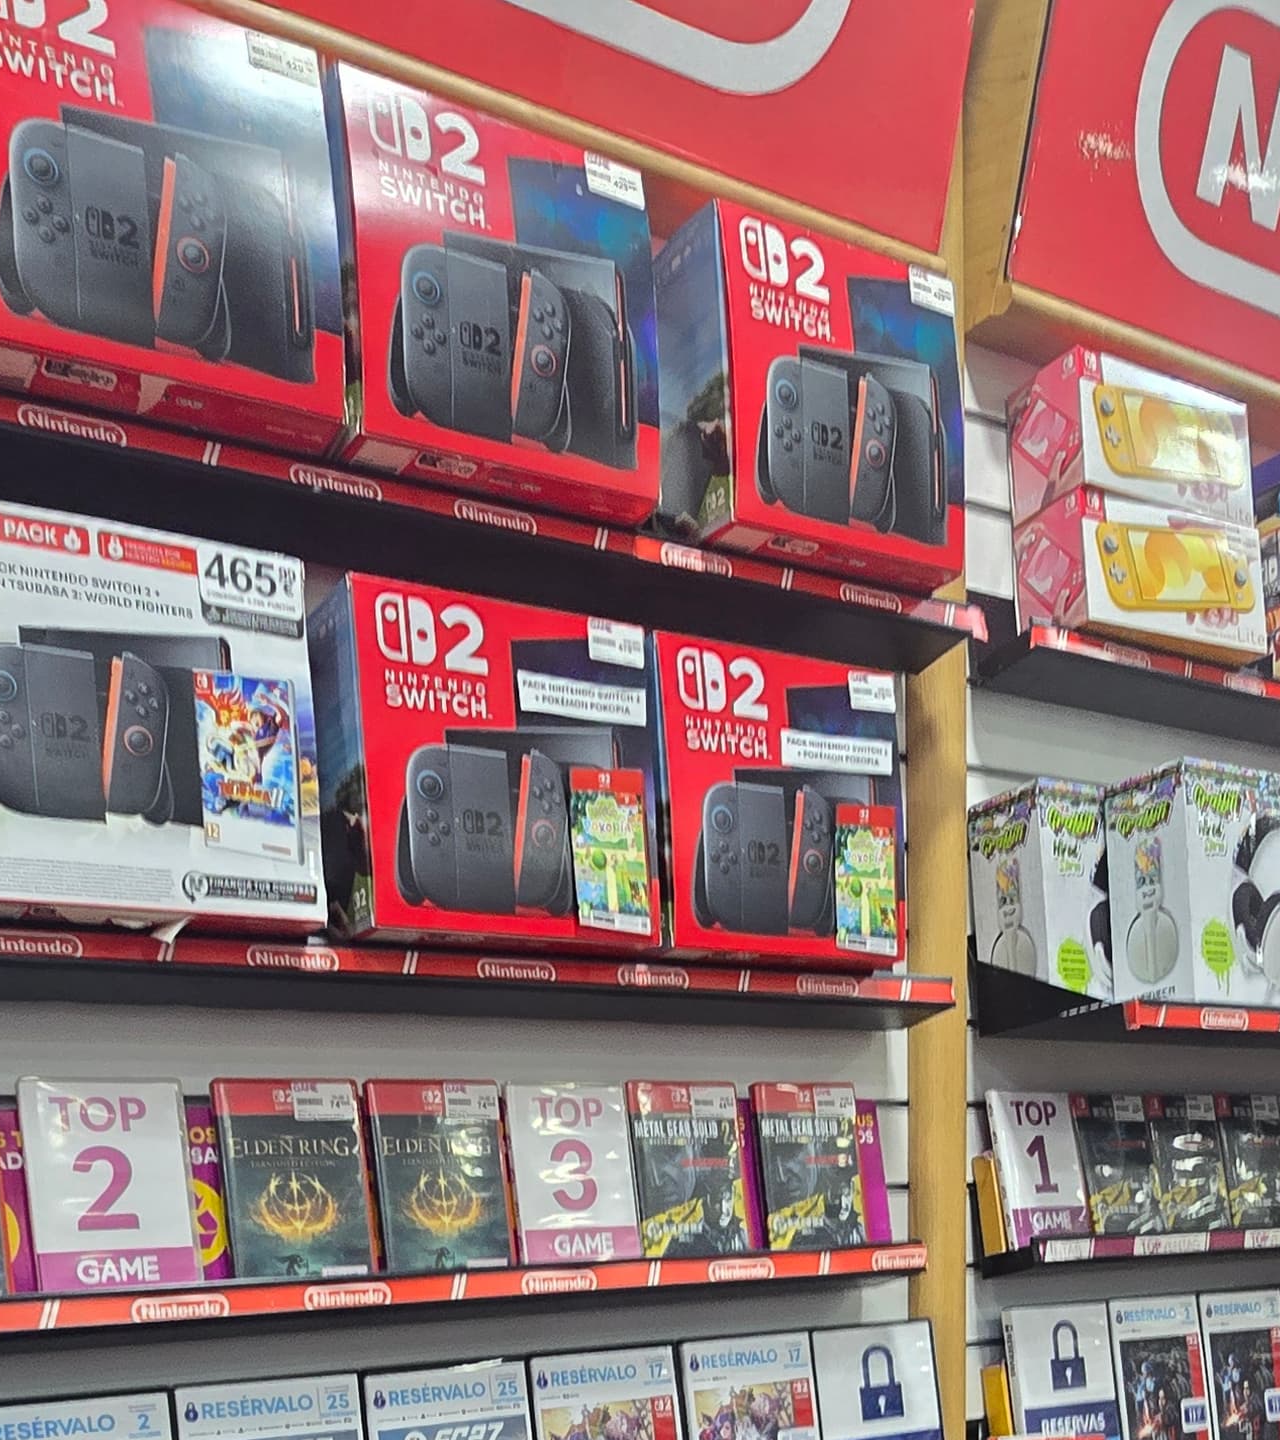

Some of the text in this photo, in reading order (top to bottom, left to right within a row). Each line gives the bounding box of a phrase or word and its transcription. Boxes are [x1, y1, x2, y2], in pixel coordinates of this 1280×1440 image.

[441, 112, 486, 184] 2
[378, 160, 484, 206] NINTENDO
[381, 176, 488, 228] SWITCH
[28, 413, 119, 445] Nintendo
[297, 469, 377, 499] Nintendo
[4, 519, 58, 547] PACK
[19, 564, 89, 586] NINTENDO
[91, 577, 140, 596] SWITCH
[204, 553, 277, 599] 465
[8, 577, 69, 598] TSUBASA
[84, 588, 133, 609] WORLD
[135, 597, 194, 619] FIGHTERS
[440, 604, 489, 675] 2
[1237, 626, 1267, 645] Lite
[385, 682, 488, 719] SWITCH
[687, 728, 768, 760] SWITCH
[48, 1096, 147, 1133] TOP
[534, 1096, 603, 1130] TOP
[1010, 1100, 1057, 1127] TOP
[231, 1136, 351, 1158] ELDEN RING
[550, 1138, 598, 1211] 3
[1025, 1135, 1059, 1194] 1
[72, 1145, 141, 1232] 2
[1031, 1210, 1071, 1232] GAME
[554, 1233, 614, 1258] GAME
[76, 1255, 161, 1284] GAME
[140, 1300, 220, 1319] Nintendo
[701, 1348, 778, 1369] RESÉRVALO
[550, 1363, 637, 1387] RESÉRVALO
[201, 1393, 350, 1420] RESÉRVALO 25
[388, 1380, 519, 1407] RESÉRVALO 25
[136, 1413, 151, 1431] 2
